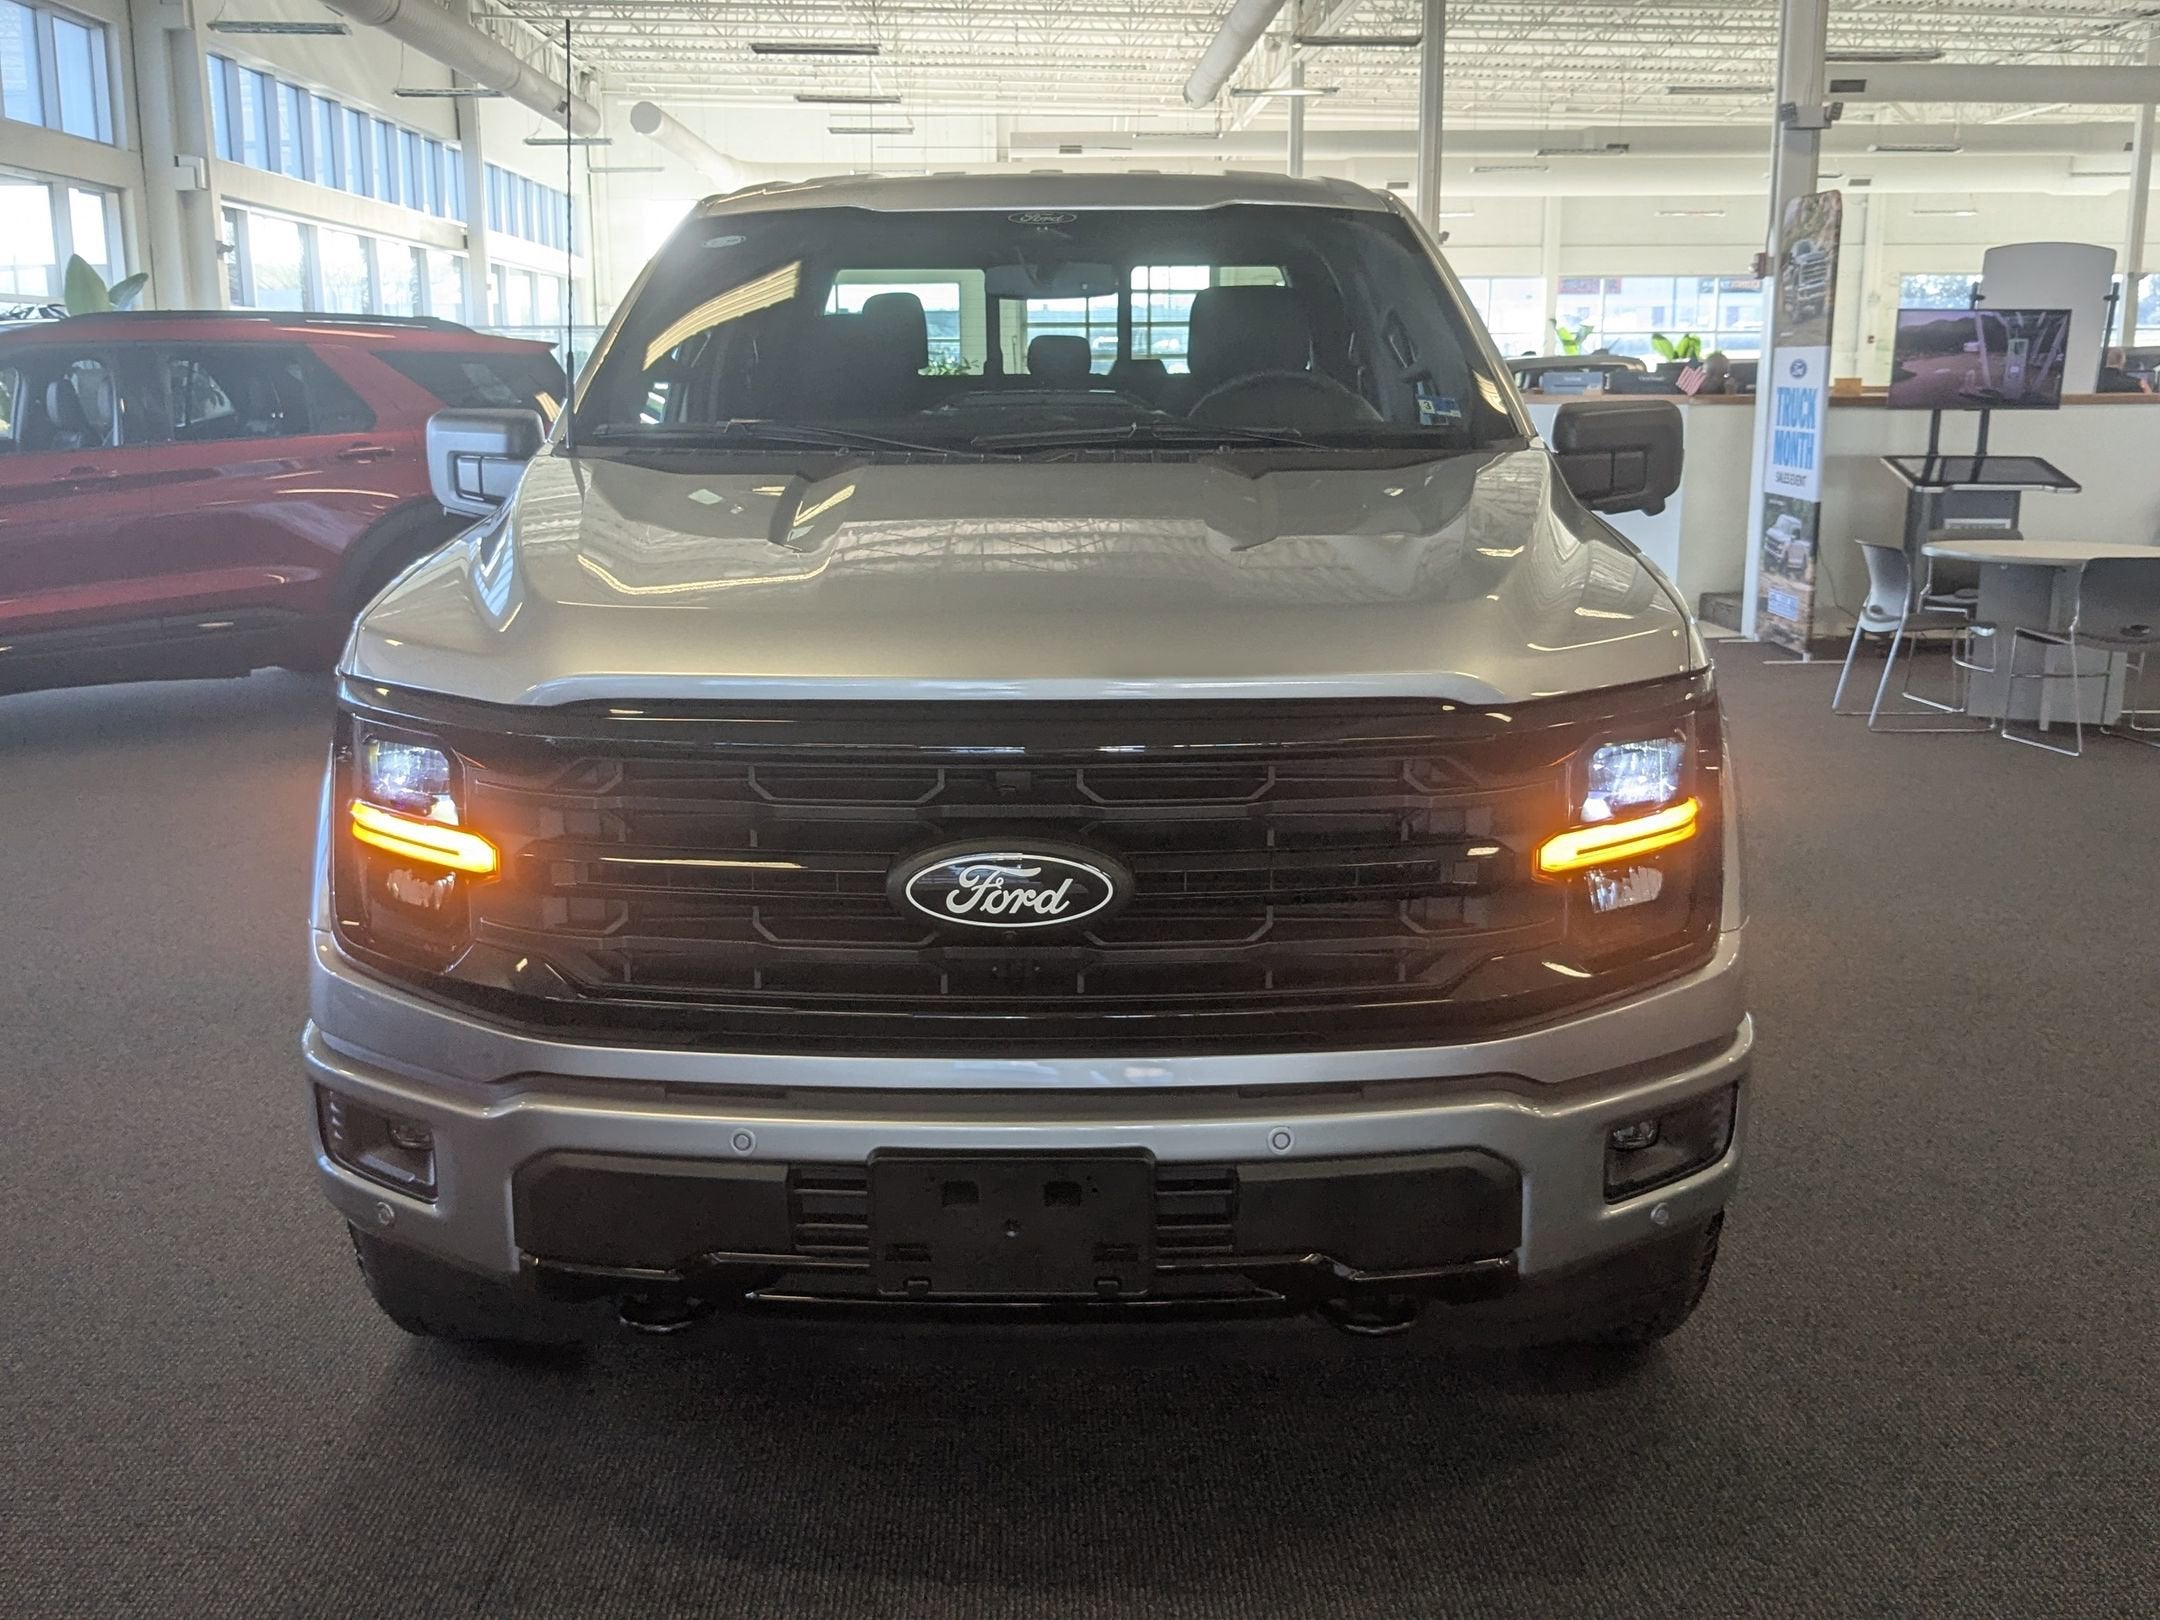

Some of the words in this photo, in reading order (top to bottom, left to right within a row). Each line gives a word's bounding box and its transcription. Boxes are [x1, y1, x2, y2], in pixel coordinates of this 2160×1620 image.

[1020, 212, 1064, 224] Ford
[1776, 386, 1818, 429] TRUCK
[1773, 430, 1815, 470] MONTH
[946, 864, 1074, 914] Ford
